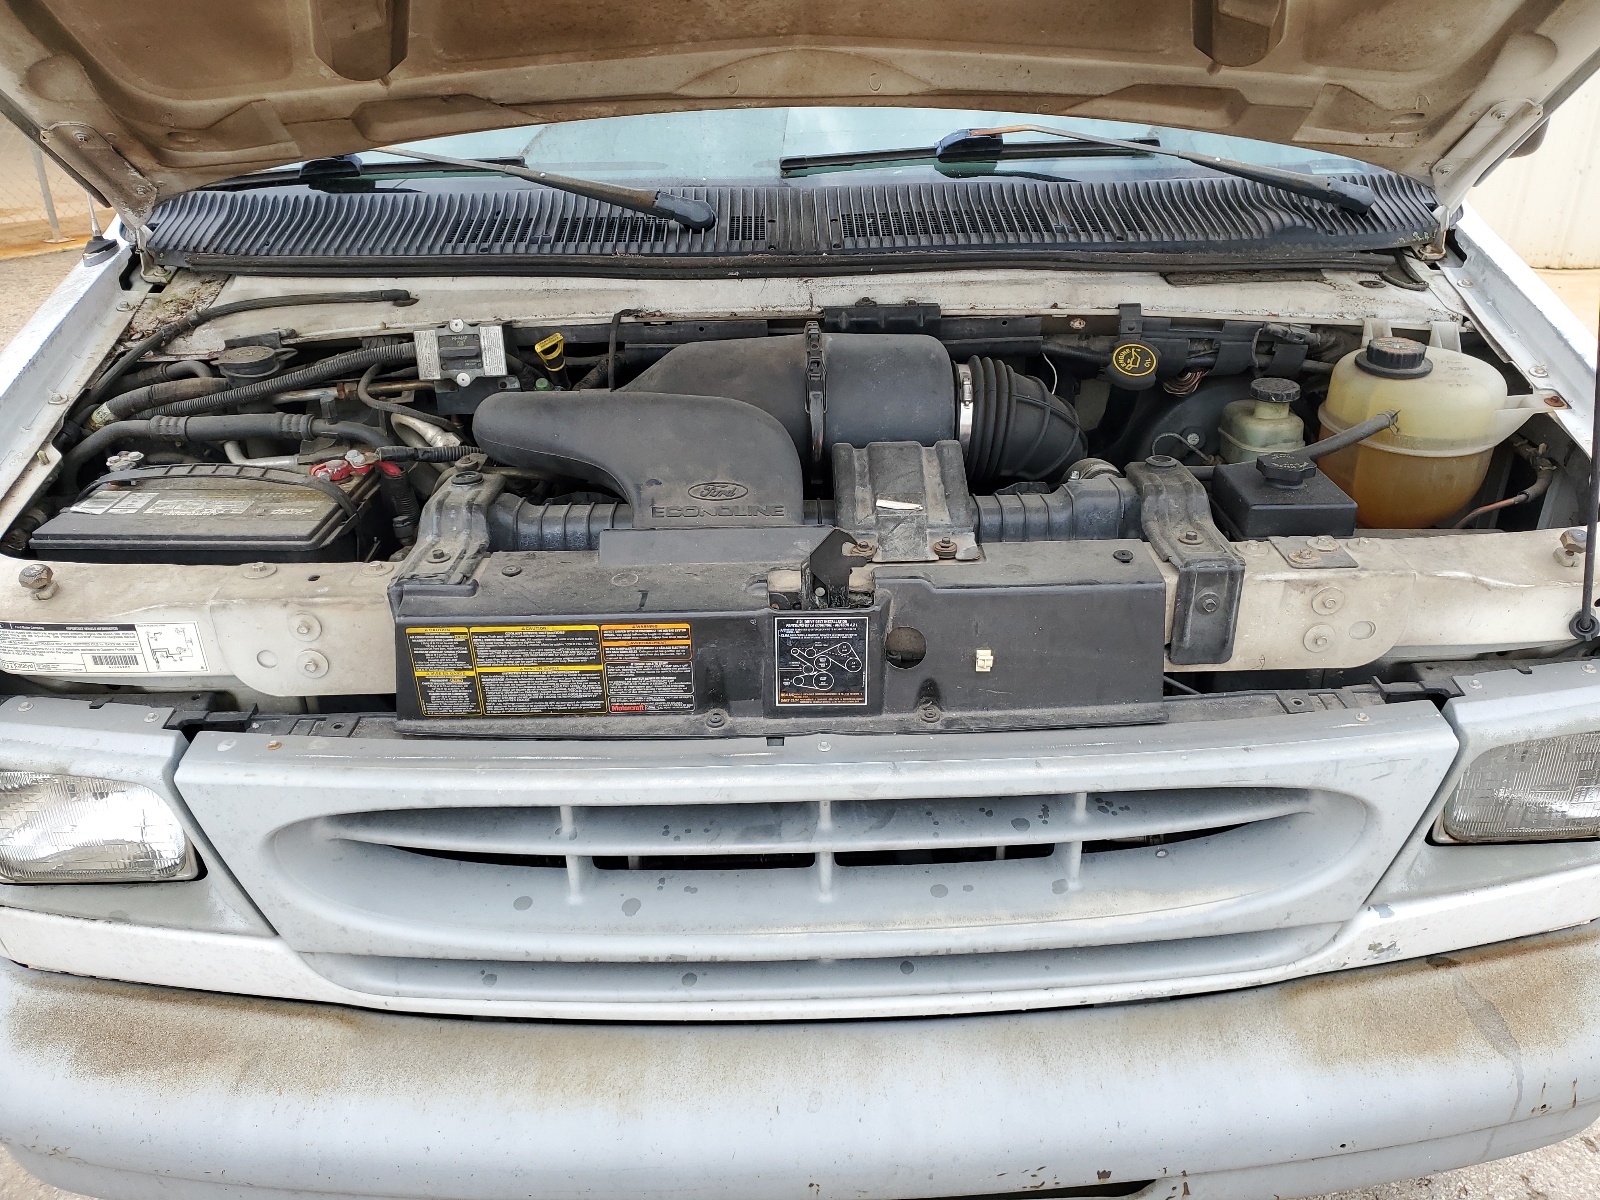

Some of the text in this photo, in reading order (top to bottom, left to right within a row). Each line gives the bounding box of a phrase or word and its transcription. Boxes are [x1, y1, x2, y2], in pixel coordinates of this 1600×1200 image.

[1118, 348, 1132, 368] ENGINE
[1144, 357, 1152, 368] OIL
[699, 484, 738, 498] Ford
[650, 504, 786, 519] ECONOLINE
[611, 704, 645, 712] Motorcraft
